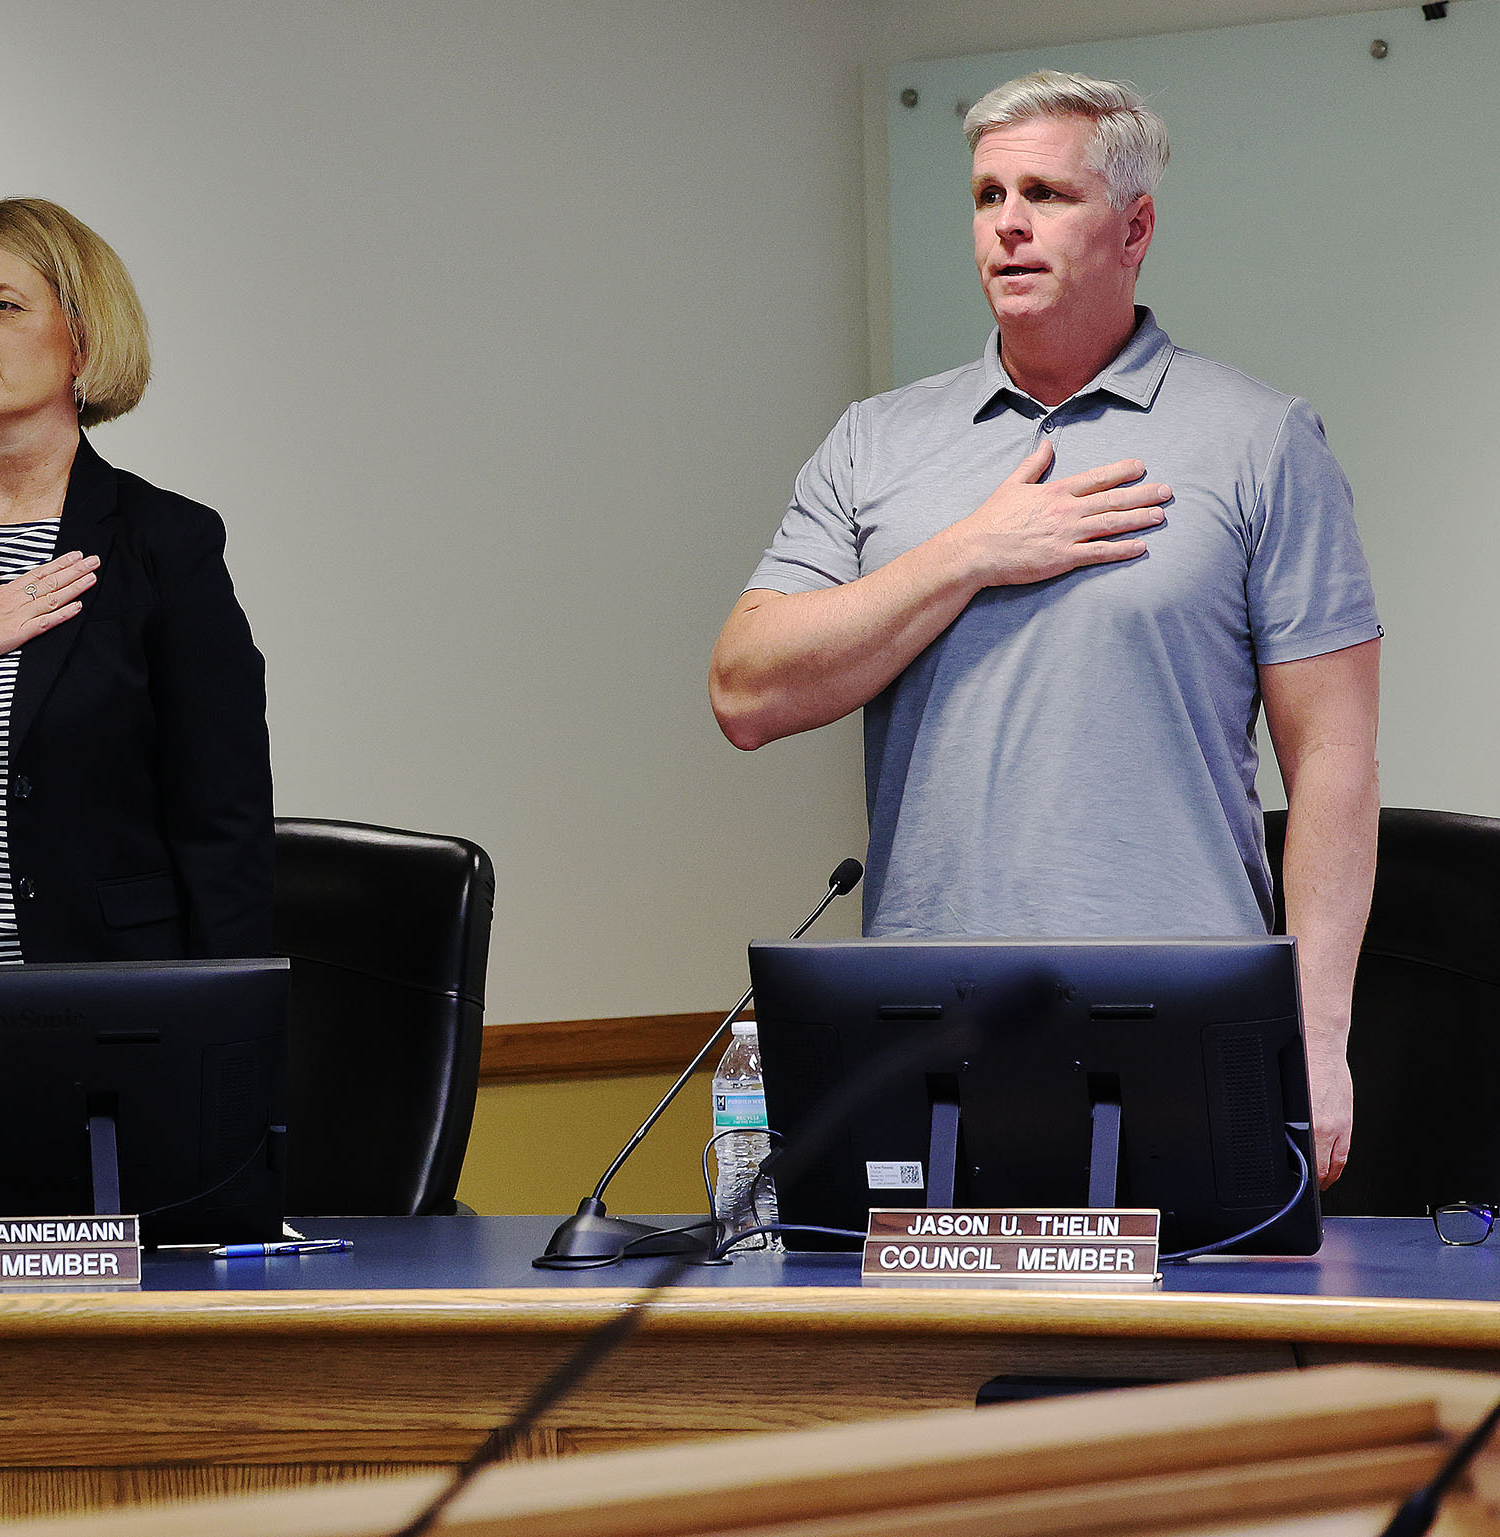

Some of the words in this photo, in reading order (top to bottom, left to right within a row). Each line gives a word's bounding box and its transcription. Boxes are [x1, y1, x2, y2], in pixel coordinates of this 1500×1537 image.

[907, 1215, 988, 1236] JASON
[1000, 1215, 1023, 1235] U.
[1036, 1215, 1120, 1236] THELIN
[1, 1254, 118, 1277] MEMBER
[880, 1246, 1000, 1271] COUNCIL
[1017, 1248, 1134, 1271] MEMBER
